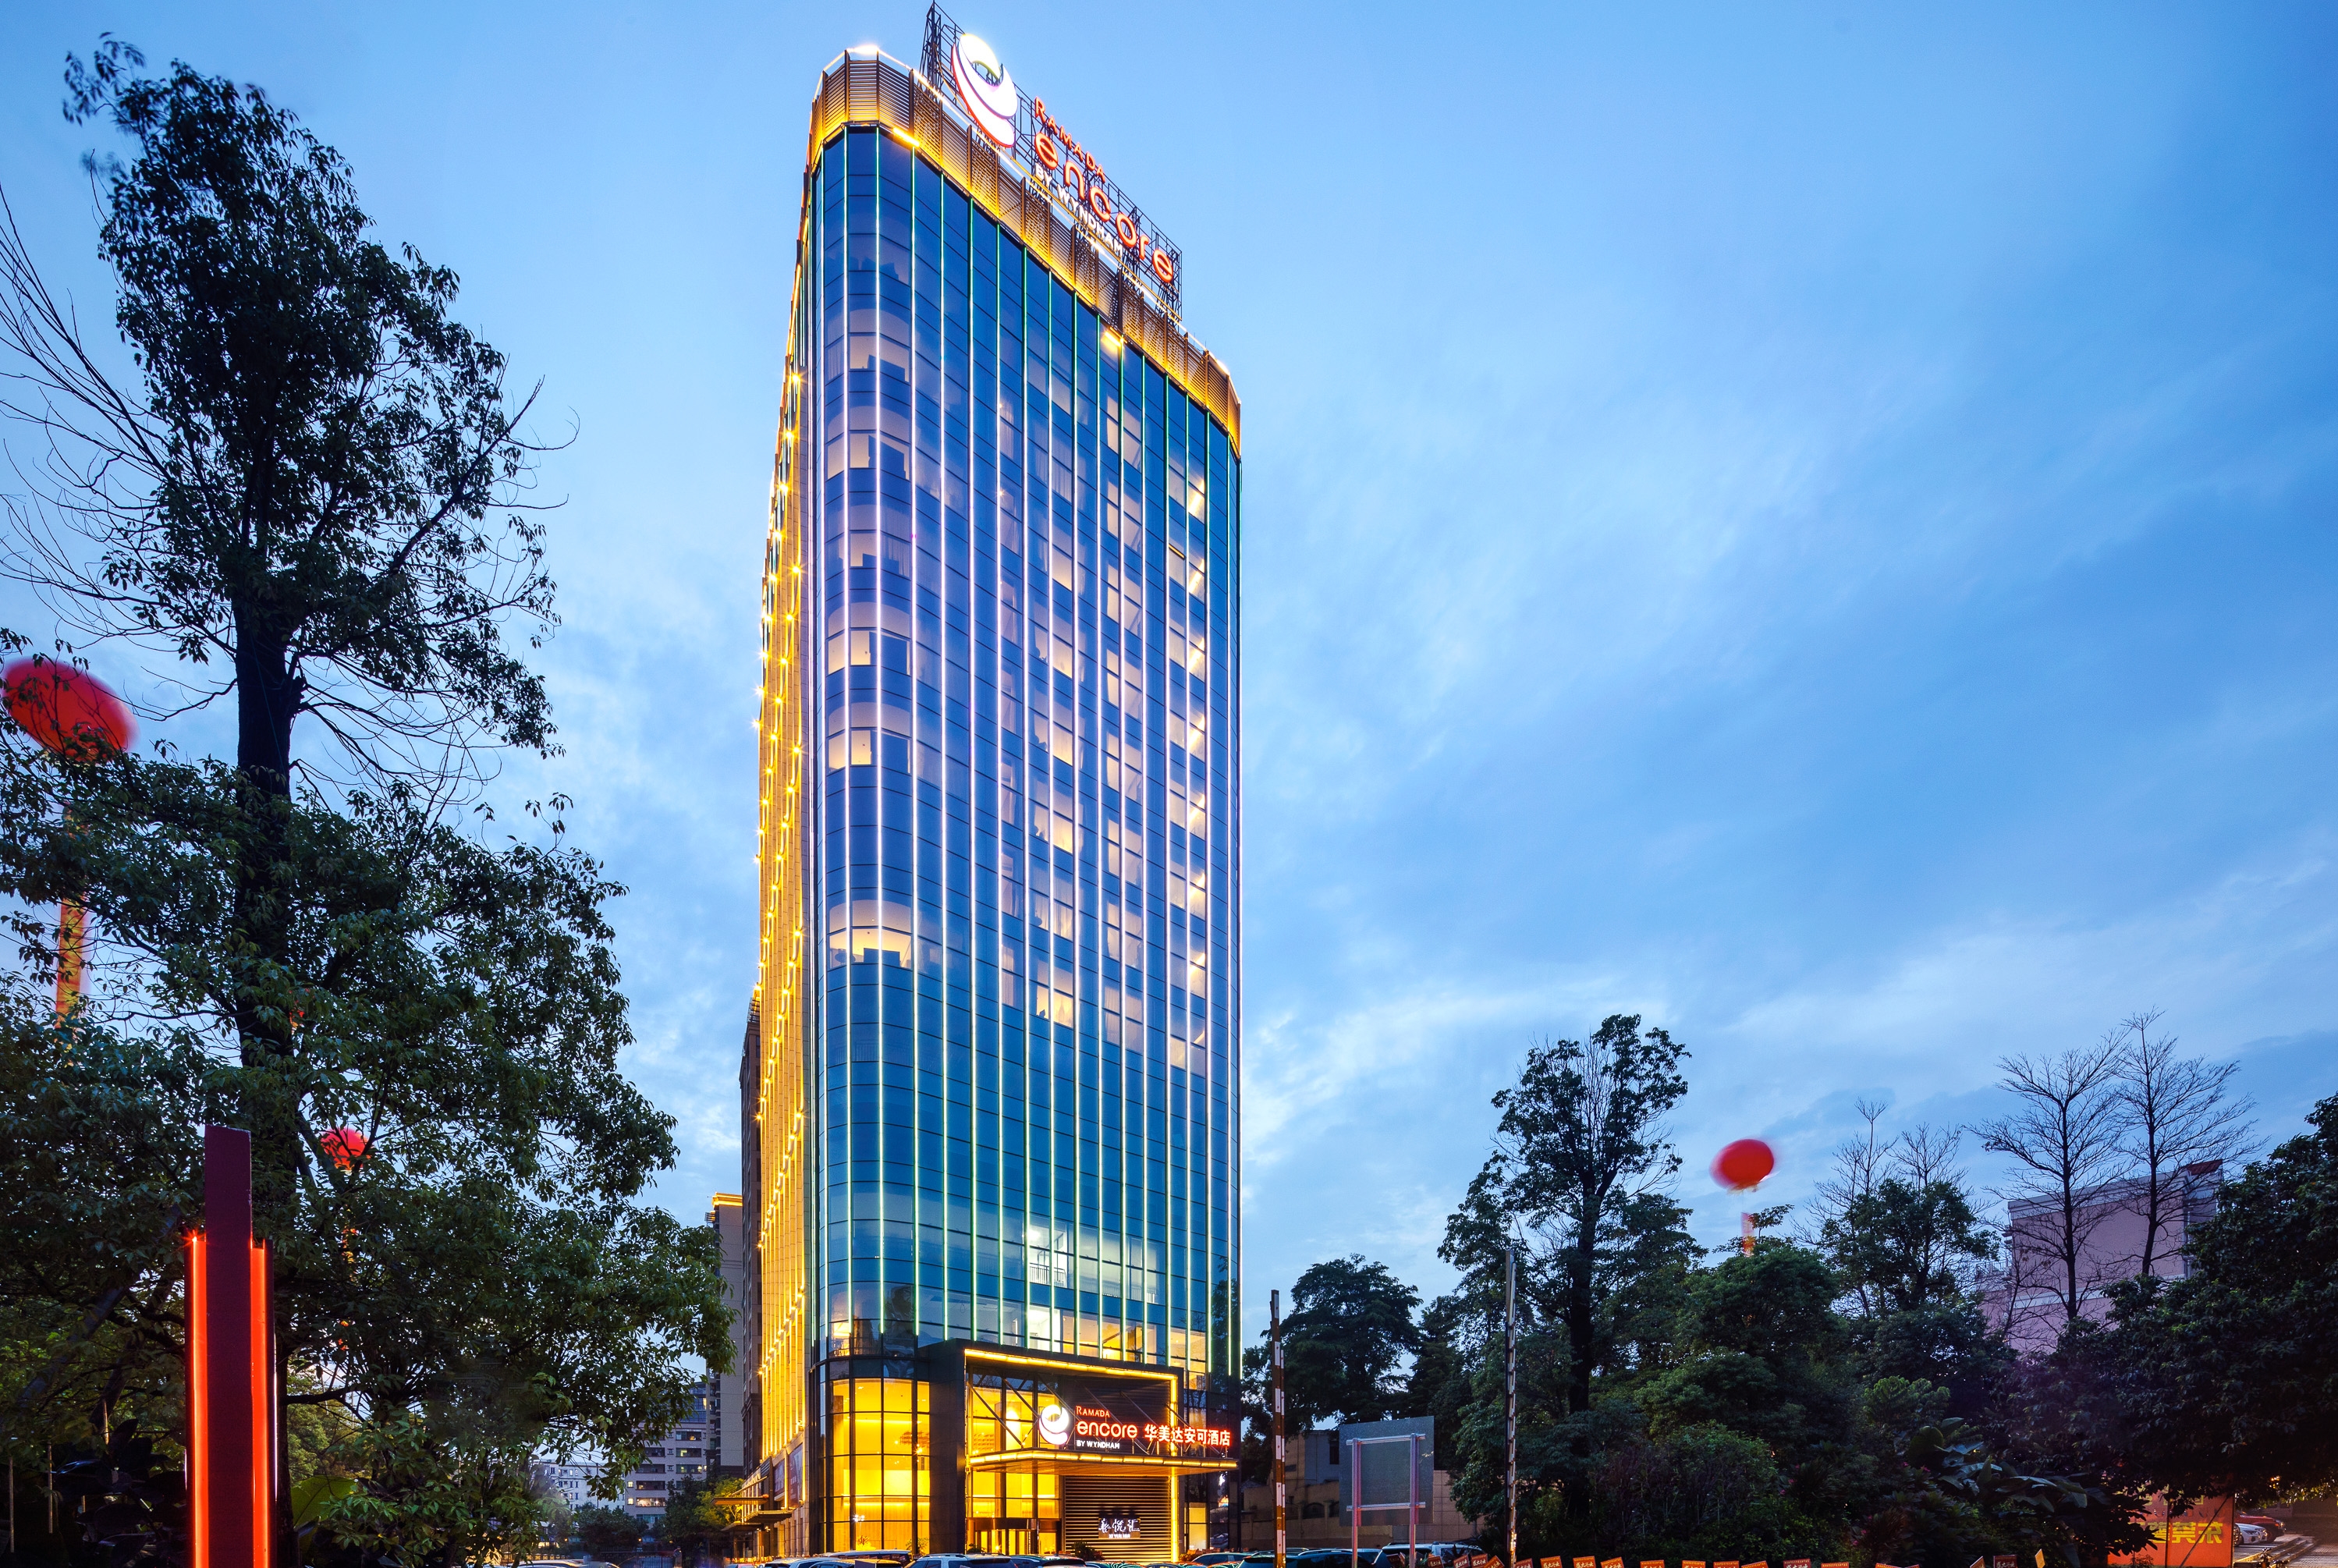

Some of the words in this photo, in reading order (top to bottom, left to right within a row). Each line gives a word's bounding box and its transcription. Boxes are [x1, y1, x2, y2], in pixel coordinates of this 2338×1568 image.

[1034, 97, 1106, 183] RAMADA
[1034, 132, 1173, 283] encore
[1034, 163, 1052, 186] BY
[1057, 183, 1124, 257] WYNDHAM
[1076, 1406, 1111, 1418] RAMADA
[1077, 1421, 1138, 1439] encore
[1144, 1424, 1231, 1446] 华美达安可酒店
[1076, 1439, 1085, 1448] BY
[1087, 1441, 1120, 1449] WYNDHAM
